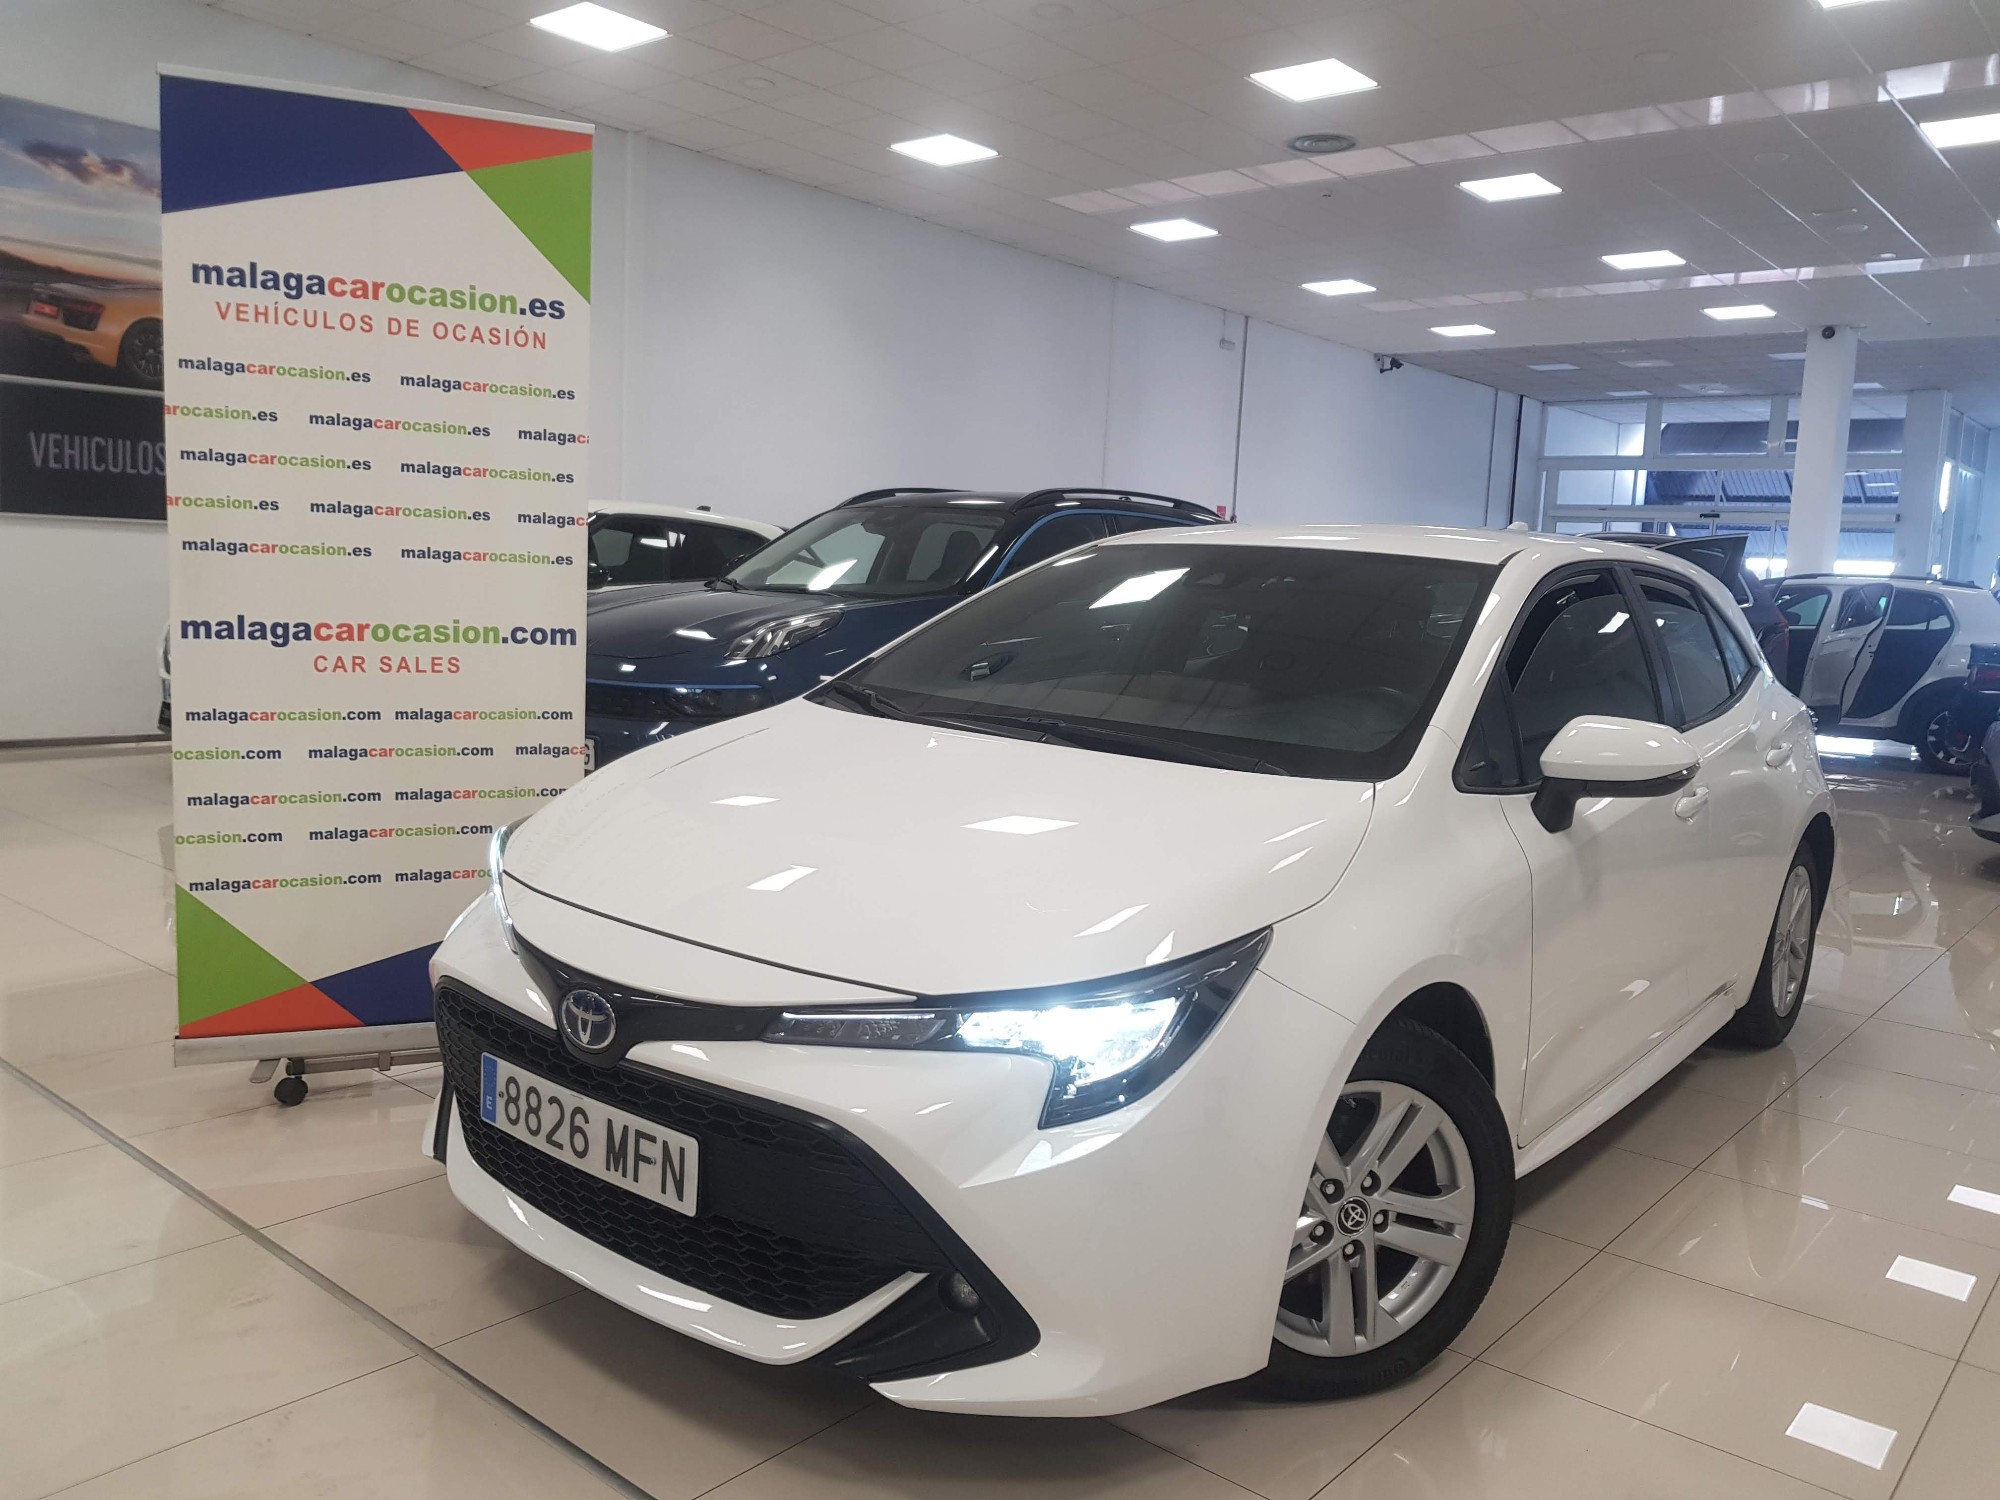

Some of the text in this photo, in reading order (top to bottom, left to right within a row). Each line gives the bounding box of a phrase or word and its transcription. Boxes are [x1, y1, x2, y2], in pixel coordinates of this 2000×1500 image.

[191, 262, 567, 320] malagacarocasion.es
[216, 301, 545, 349] VEHÍCULOS DE OCASIÓN
[178, 357, 371, 383] malagacarocasion.es
[401, 375, 575, 400] malagacarocasion.es
[309, 413, 490, 437] malagacarocasion.es
[29, 431, 165, 476] VEHICULOS
[180, 448, 371, 470] malagacarocasion.es
[401, 461, 574, 483] malagacarocasion.es
[310, 501, 490, 521] malagacarocasion.es
[182, 538, 372, 557] malagacarocasion.es
[401, 547, 573, 565] malagacarocasion.es
[181, 614, 576, 648] malagacarocasion.com
[314, 655, 460, 673] CAR SALES
[186, 708, 381, 724] malagacarocasion.com
[395, 708, 573, 723] malagacarocasion.com
[173, 747, 281, 760] ocasion.com
[309, 745, 493, 761] malagacarocasion.com
[187, 791, 381, 808] malagacarocasion.com
[175, 831, 282, 845] ocasion.com
[309, 824, 493, 842] malagacarocasion.com
[188, 874, 382, 892] malagacarocasion.com
[486, 1096, 492, 1110] E
[504, 1076, 686, 1203] 8826 MFN
